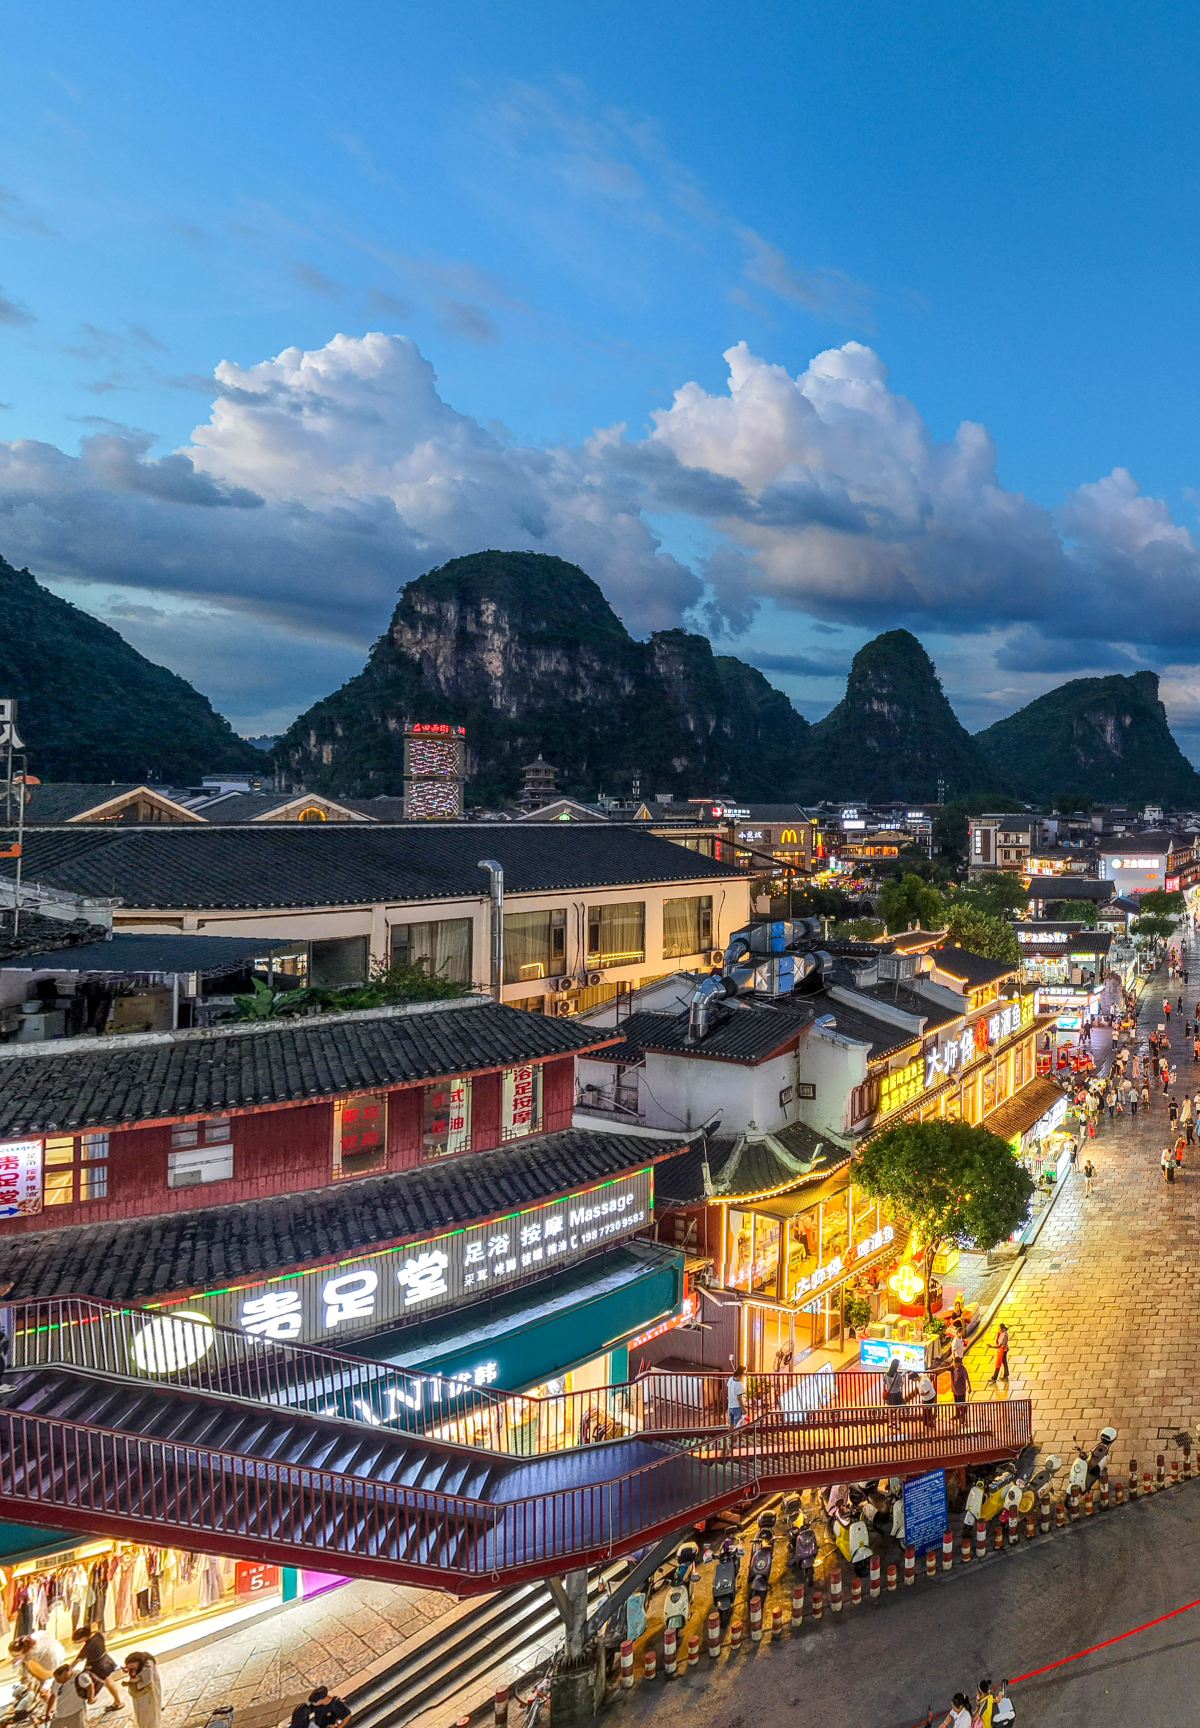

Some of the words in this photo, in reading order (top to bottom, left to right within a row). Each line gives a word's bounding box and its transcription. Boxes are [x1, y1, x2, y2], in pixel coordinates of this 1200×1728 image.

[988, 1002, 1022, 1043] 啤酒鱼
[512, 1066, 533, 1126] 浴足按摩
[464, 1233, 510, 1267] 足浴
[520, 1215, 564, 1248] 按摩
[569, 1193, 634, 1228] Massage
[464, 1269, 488, 1287] 采耳
[581, 1231, 598, 1244] 198
[599, 1221, 621, 1238] 7730
[622, 1211, 645, 1228] 9583
[240, 1250, 449, 1344] 贵足堂
